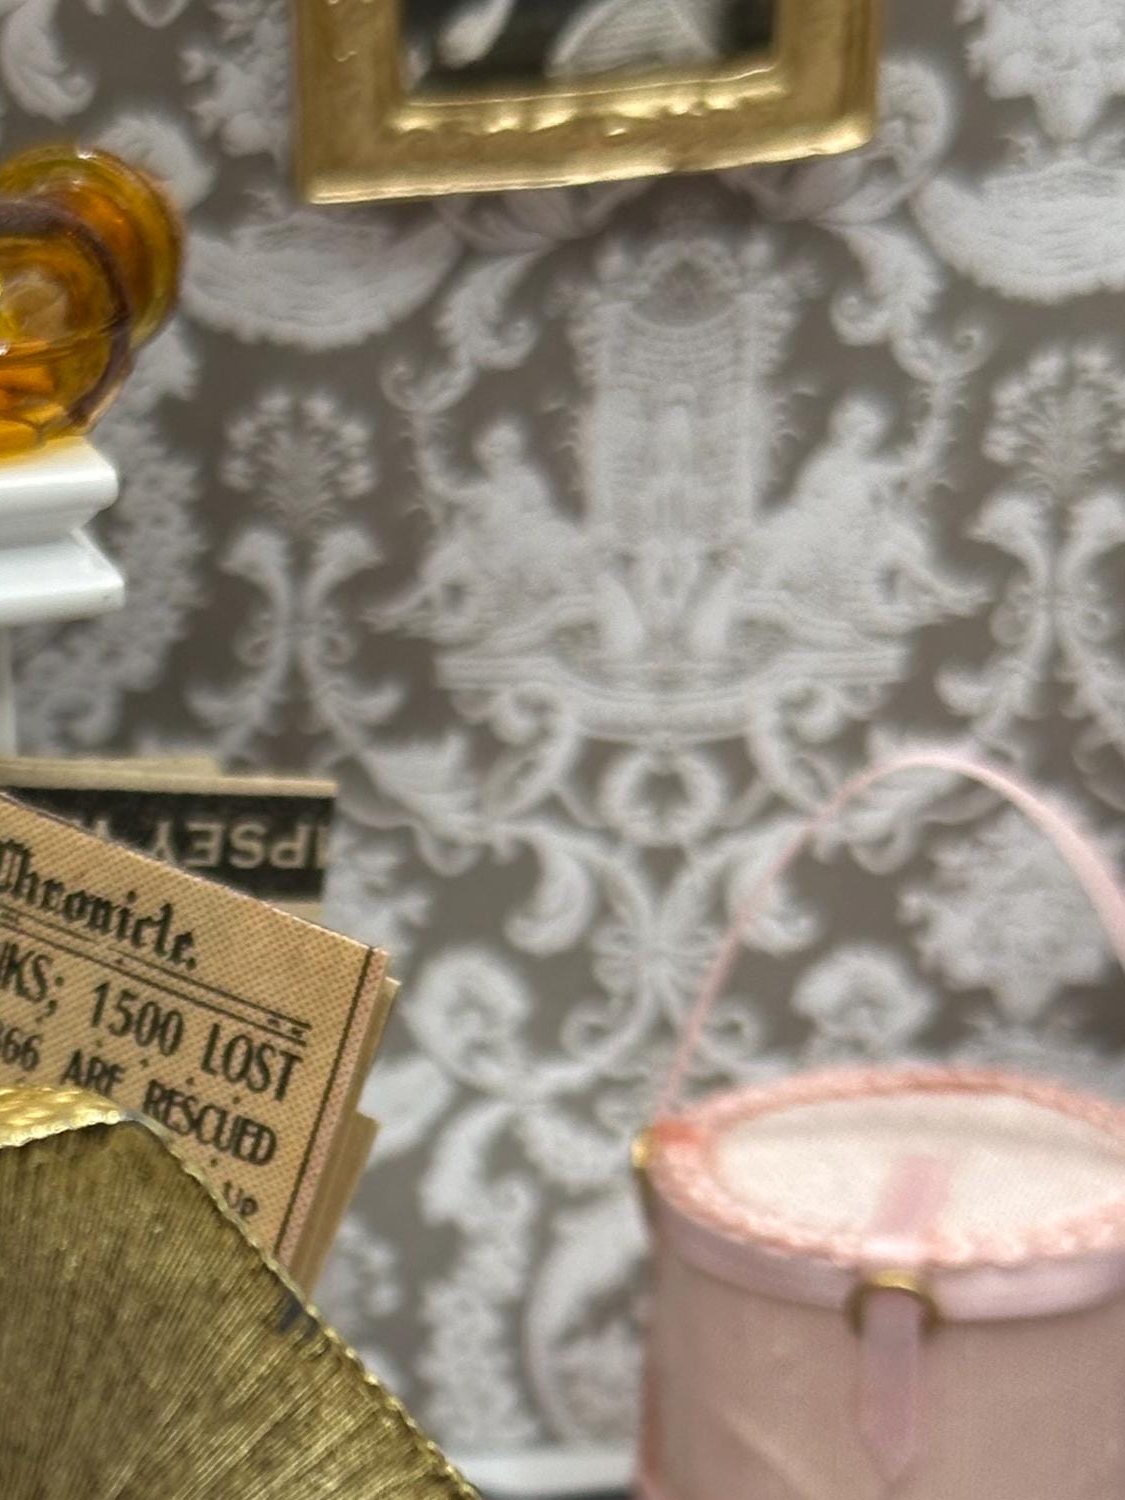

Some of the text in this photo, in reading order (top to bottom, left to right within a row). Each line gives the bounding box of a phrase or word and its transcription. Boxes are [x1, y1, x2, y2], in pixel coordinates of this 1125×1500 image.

[89, 982, 184, 1058] 1500
[200, 1022, 303, 1102] LOST
[59, 1049, 126, 1099] ARE
[142, 1079, 278, 1167] RESCUED
